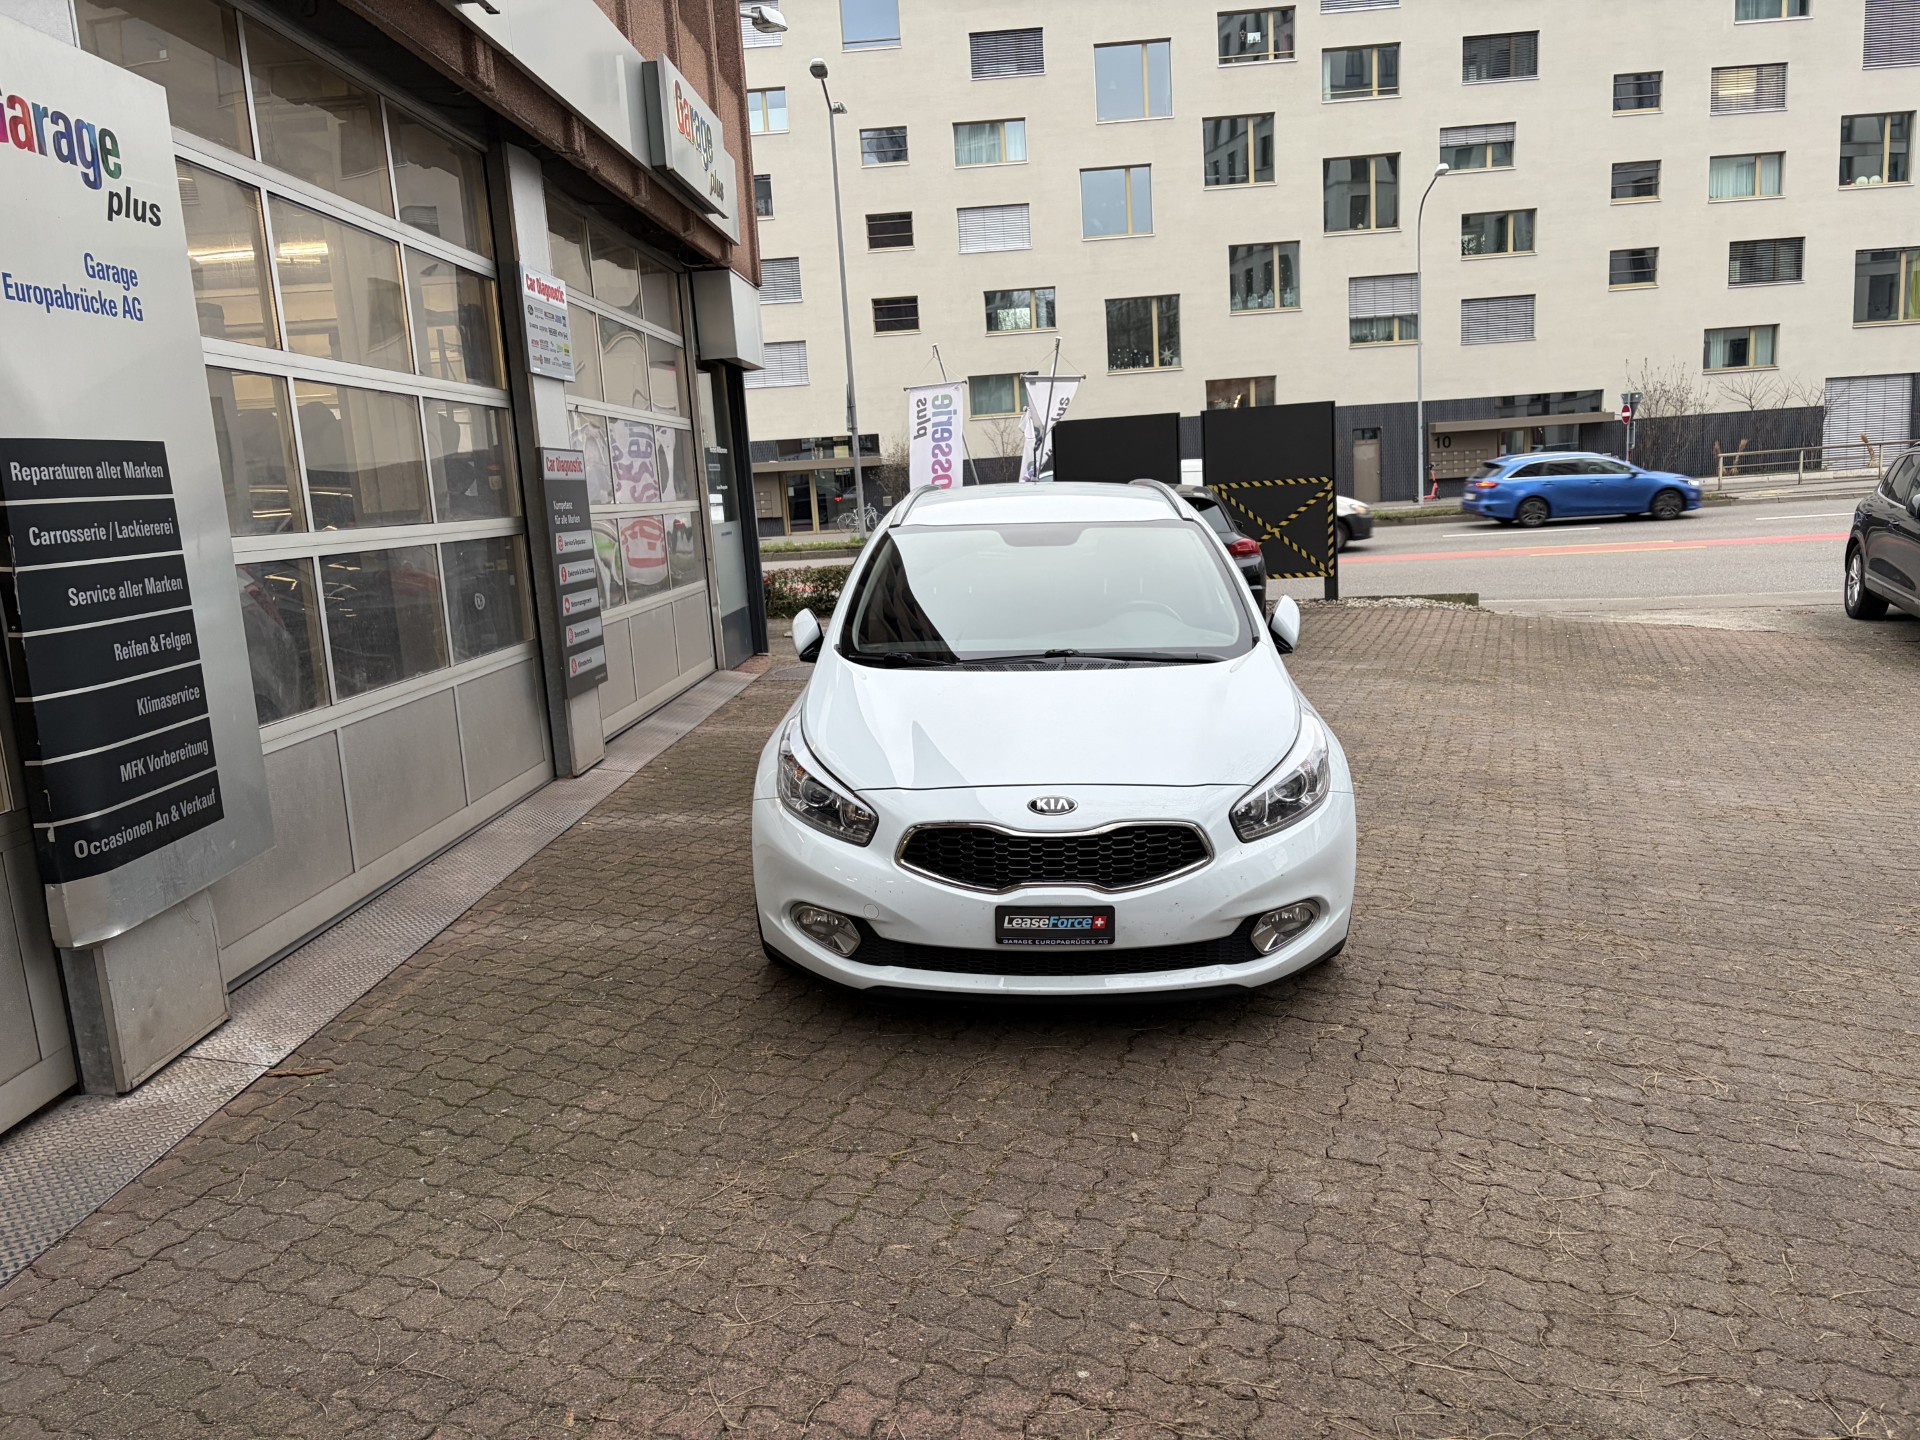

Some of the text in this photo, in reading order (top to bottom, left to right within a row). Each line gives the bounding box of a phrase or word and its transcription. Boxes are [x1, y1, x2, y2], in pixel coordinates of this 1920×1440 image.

[0, 88, 122, 190] arage
[673, 80, 713, 171] Garage
[710, 169, 724, 202] plus
[107, 186, 162, 226] plus
[83, 252, 138, 291] Garage
[2, 271, 143, 322] Europabrücke AG
[525, 273, 565, 304] Car Diagnostic
[1434, 435, 1451, 448] 10
[10, 461, 163, 485] Reparaturen aller Marken
[546, 456, 583, 476] Car Diagnostic
[29, 517, 174, 546] Carrosserie / Lackiererei
[68, 576, 183, 607] Service aller Marken
[114, 632, 192, 661] Reifen & Felgen
[136, 685, 200, 716] Klimaservice
[120, 738, 209, 783] MFK Vorbereitung
[1036, 798, 1070, 810] KIA
[74, 788, 216, 858] Occasionen An & Verkauf
[1003, 916, 1092, 928] LeaseForce
[1035, 937, 1096, 945] EUROPABRÜCKE
